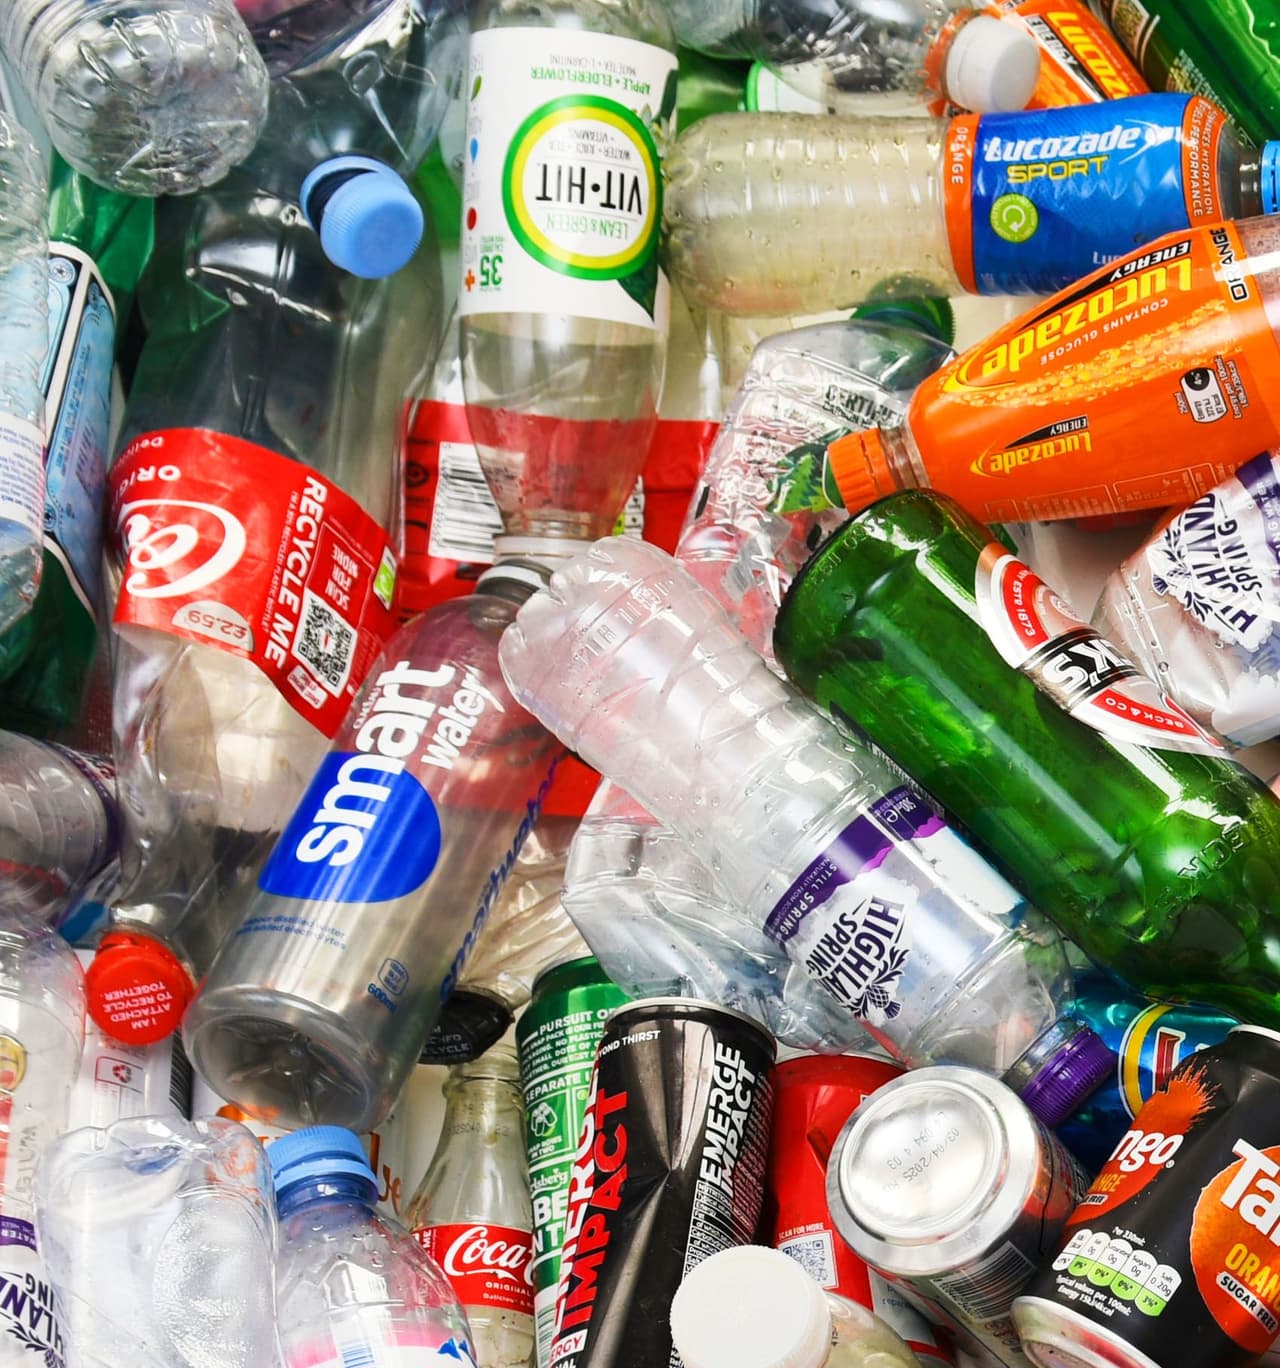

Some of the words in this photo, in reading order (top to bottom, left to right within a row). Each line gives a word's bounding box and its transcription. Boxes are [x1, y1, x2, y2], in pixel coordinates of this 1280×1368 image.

[984, 125, 1137, 163] Lucozade
[1007, 156, 1110, 183] SPORT
[480, 255, 503, 286] 35
[1110, 240, 1191, 282] ENERGY
[1209, 227, 1250, 303] ORANGE
[981, 257, 1193, 378] Lucozade
[1103, 299, 1169, 333] CONTAINS
[1040, 329, 1098, 366] GLUCOSE
[989, 429, 1094, 475] Lucozade
[278, 475, 328, 616] RECYCLE
[1217, 519, 1263, 592] SPRING
[265, 613, 295, 669] ME
[420, 670, 505, 771] water
[295, 659, 458, 868] smart
[103, 995, 155, 1012] RECYCLE
[104, 981, 166, 1001] TOGETHER
[110, 1003, 170, 1022] ATTACHED
[701, 1043, 741, 1185] EMERGE
[719, 1058, 756, 1201] IMPACT
[563, 1088, 628, 1331] IMPACT
